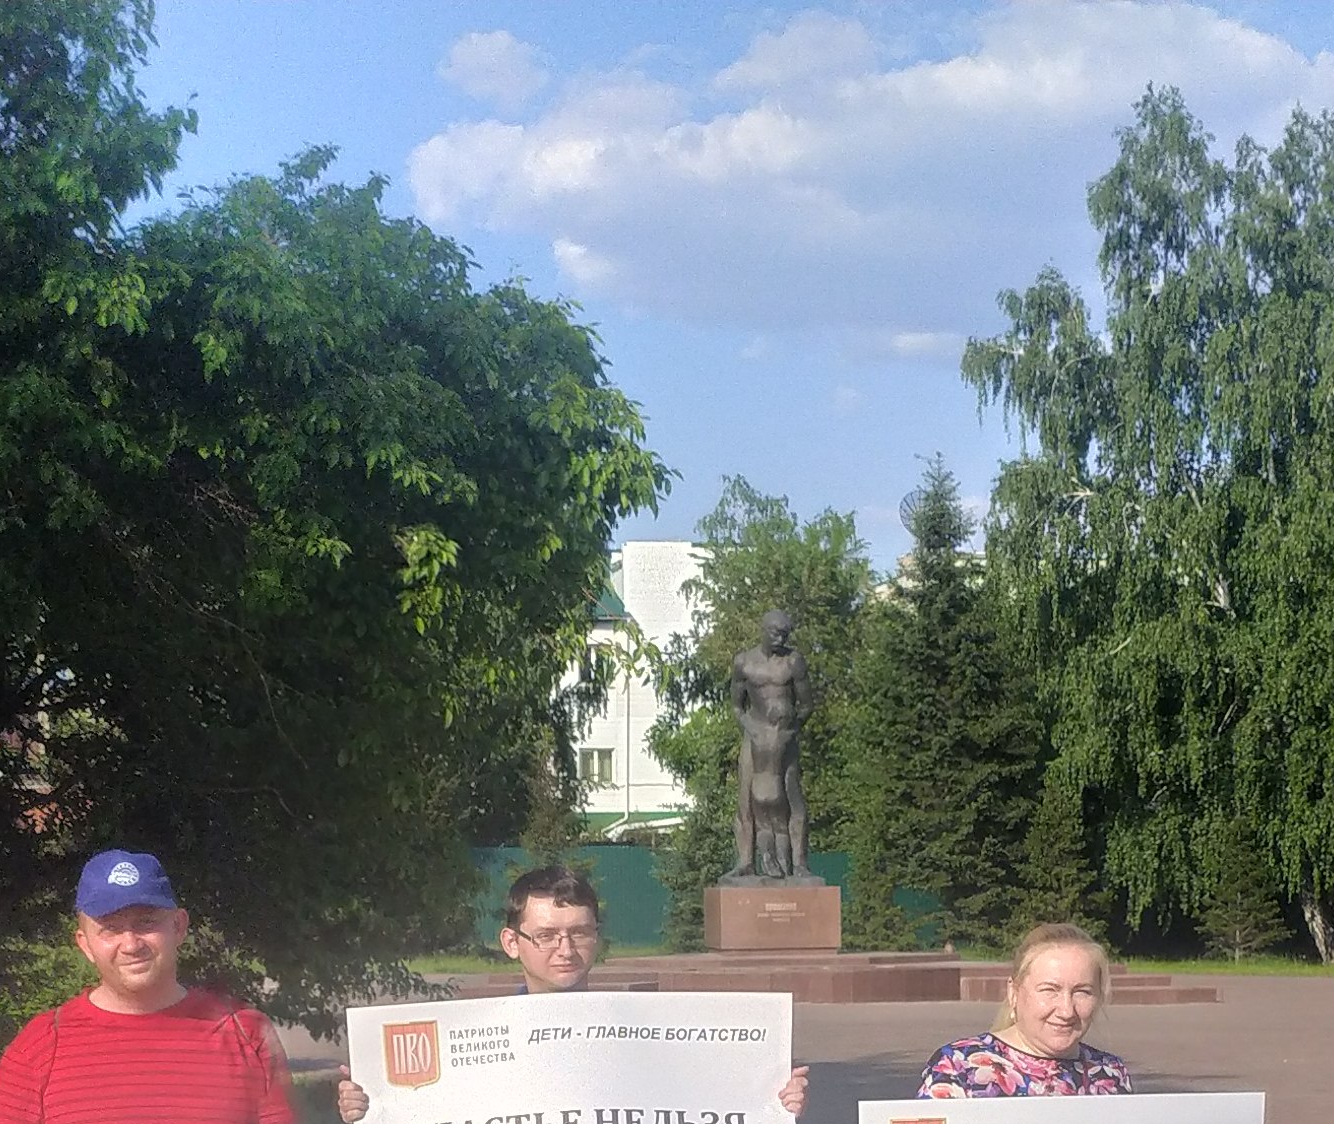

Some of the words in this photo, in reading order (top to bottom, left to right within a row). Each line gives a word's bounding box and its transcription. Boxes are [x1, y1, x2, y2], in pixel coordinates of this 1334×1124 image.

[449, 1025, 509, 1039] ПАТРИОТЫ
[528, 1026, 572, 1045] ДЕТИ
[586, 1024, 661, 1041] ГЛАВНОЕ
[665, 1026, 767, 1043] БОГАТСТВО!
[450, 1038, 511, 1054] ВЕЛИКОГО
[393, 1034, 432, 1075] ПВО
[451, 1052, 516, 1068] ОТЕЧЕСТВА
